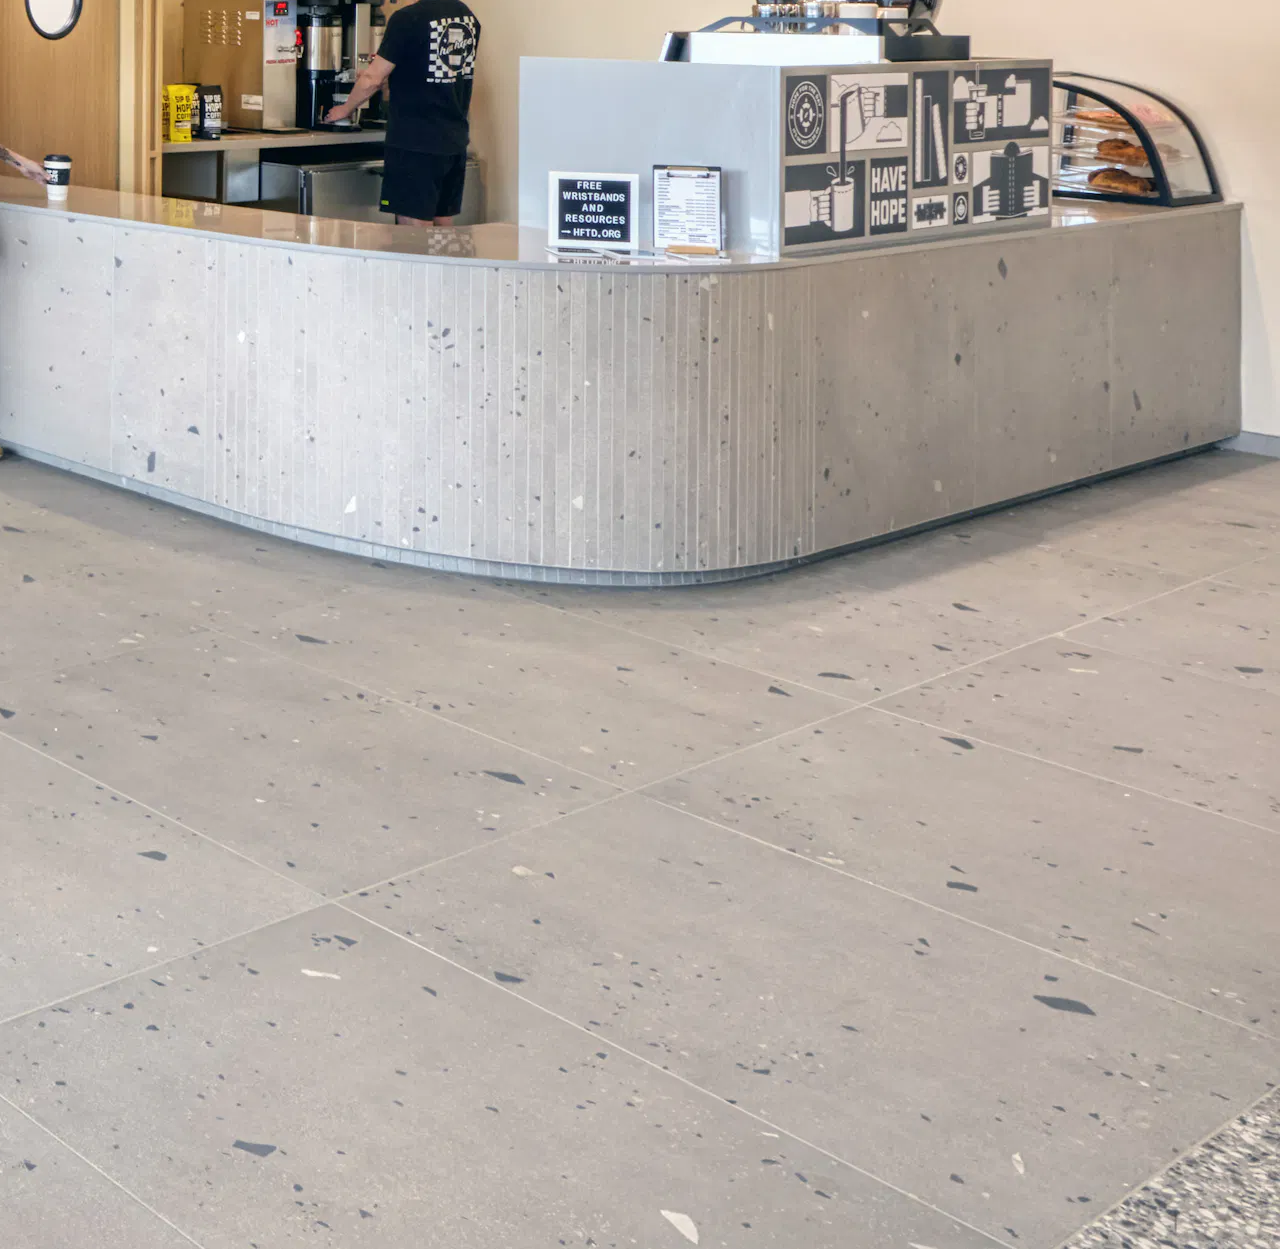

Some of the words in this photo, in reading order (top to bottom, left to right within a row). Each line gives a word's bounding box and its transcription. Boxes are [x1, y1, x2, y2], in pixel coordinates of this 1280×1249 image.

[177, 103, 191, 113] HOP
[871, 165, 907, 193] HAVE
[577, 181, 602, 190] FREE
[562, 191, 625, 202] WRISTBANDS
[581, 203, 604, 213] AND
[871, 198, 907, 226] HOPE
[565, 214, 626, 225] RESOURCES
[573, 228, 621, 239] HFTD.ORG
